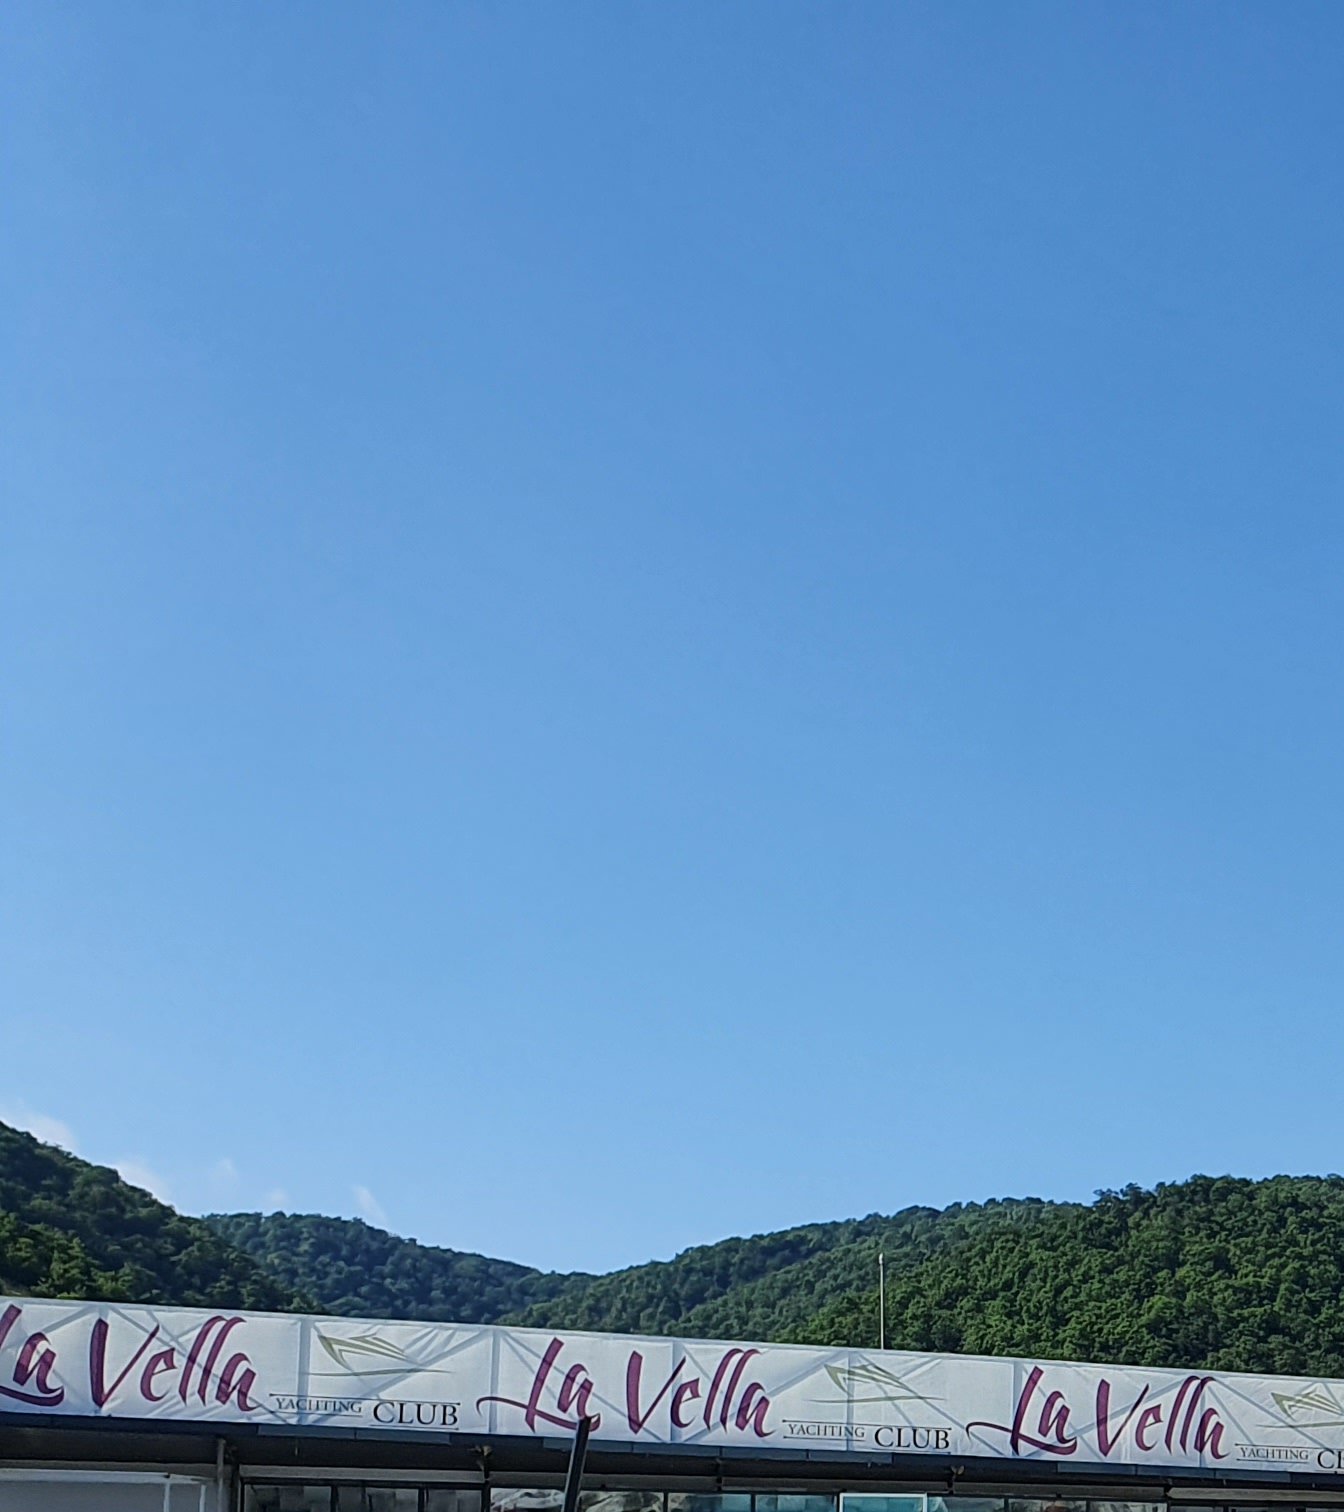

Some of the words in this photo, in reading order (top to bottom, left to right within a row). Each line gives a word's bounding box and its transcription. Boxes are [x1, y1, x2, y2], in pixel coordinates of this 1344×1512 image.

[90, 1315, 260, 1412] Vella
[476, 1337, 601, 1433] La
[626, 1348, 777, 1438] Vella
[275, 1397, 362, 1414] YACHTING
[373, 1401, 458, 1426] CLUB
[788, 1423, 865, 1439] YACHTING
[874, 1427, 950, 1450] CLUB
[966, 1365, 1077, 1456] La
[1096, 1375, 1231, 1460] Vella
[1240, 1446, 1309, 1461] YACHTING
